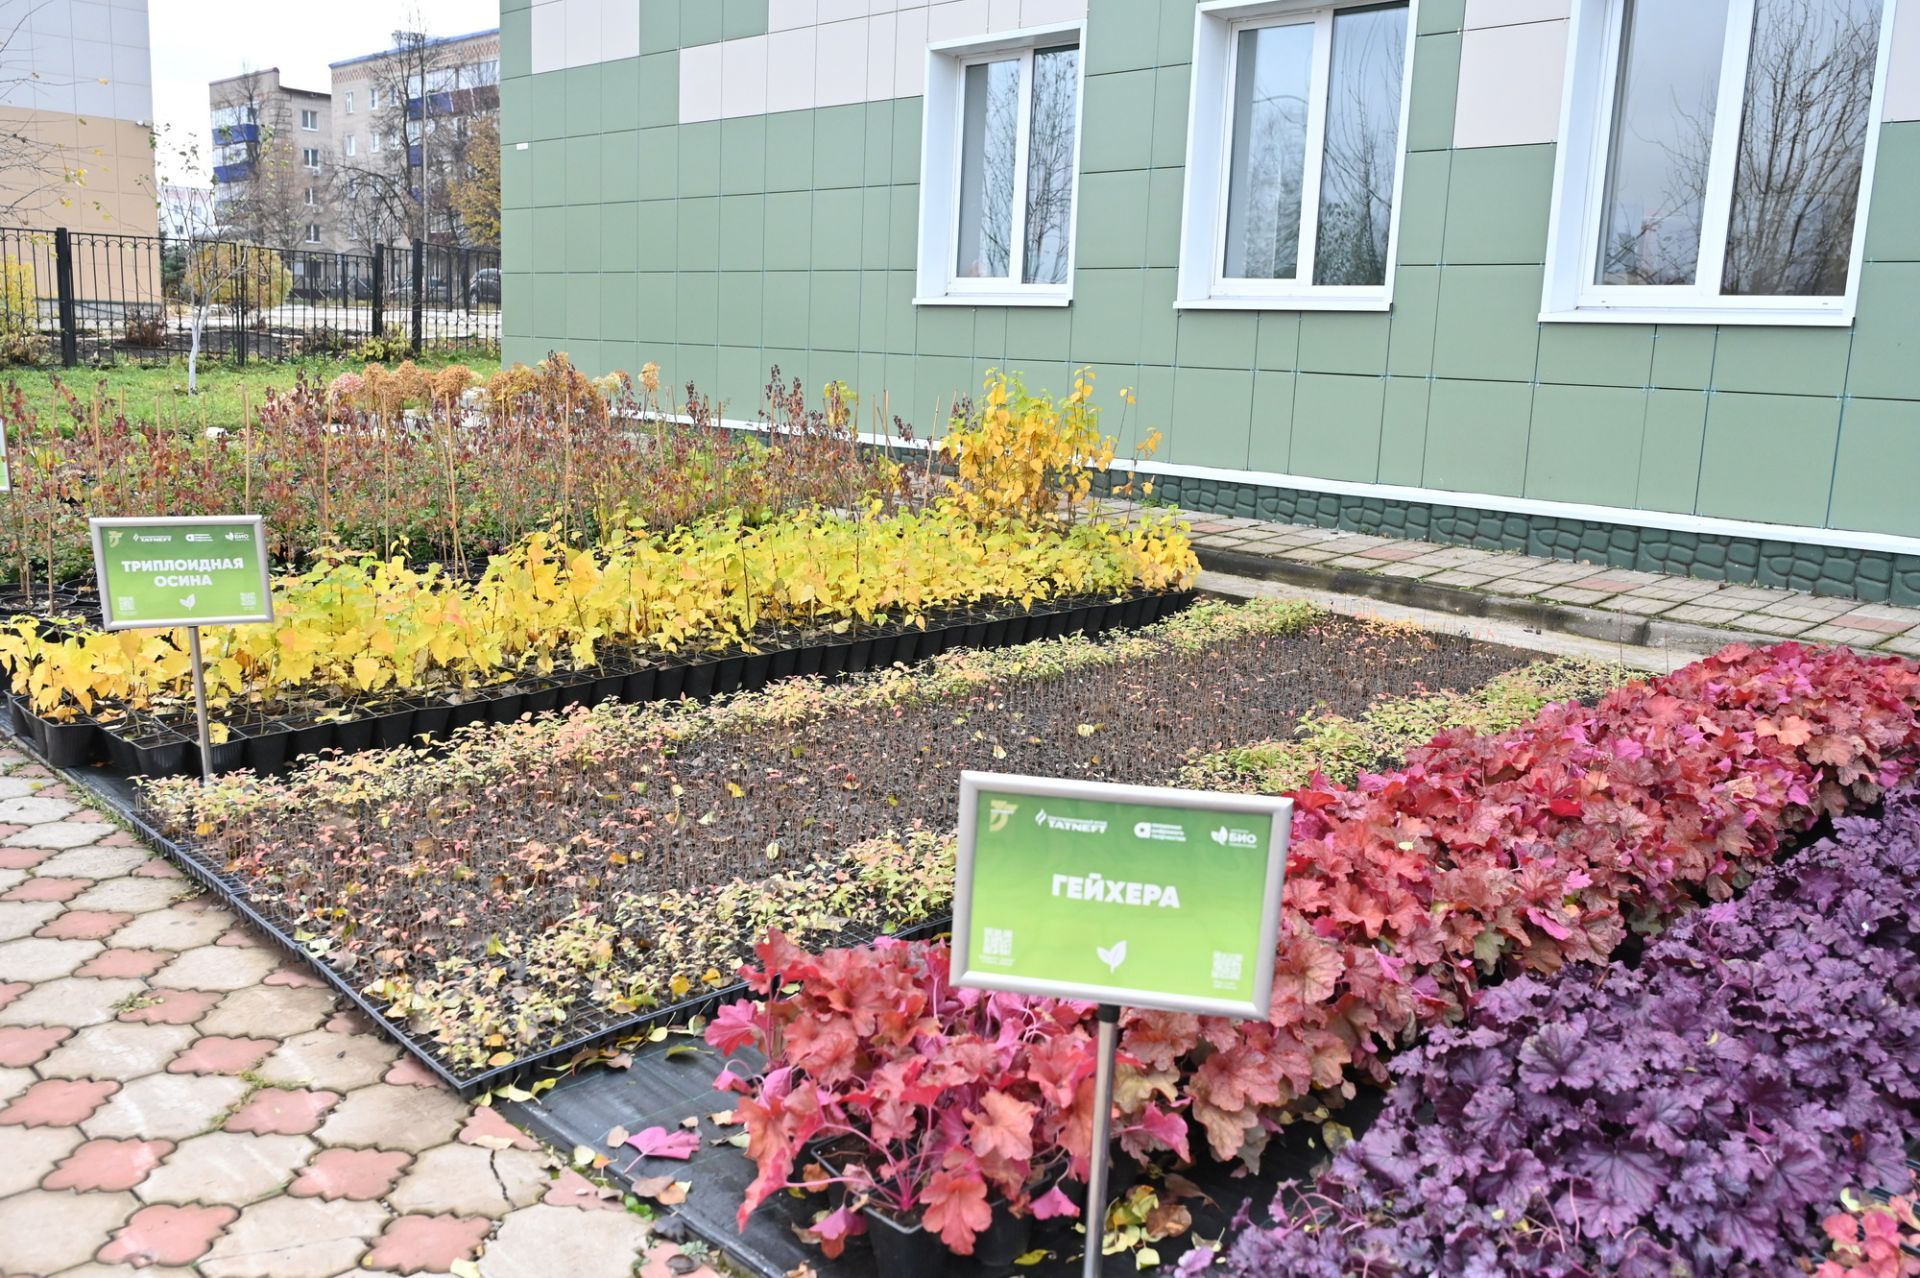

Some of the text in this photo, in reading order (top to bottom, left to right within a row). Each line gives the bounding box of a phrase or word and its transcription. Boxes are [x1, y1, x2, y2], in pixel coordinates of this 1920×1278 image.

[121, 557, 244, 573] ТРИПЛОИДНАЯ
[154, 574, 213, 587] ОСИНА
[1048, 820, 1108, 834] TATNEFT
[1228, 832, 1257, 844] БИО
[1052, 873, 1180, 909] ГЕЙХЕРА
